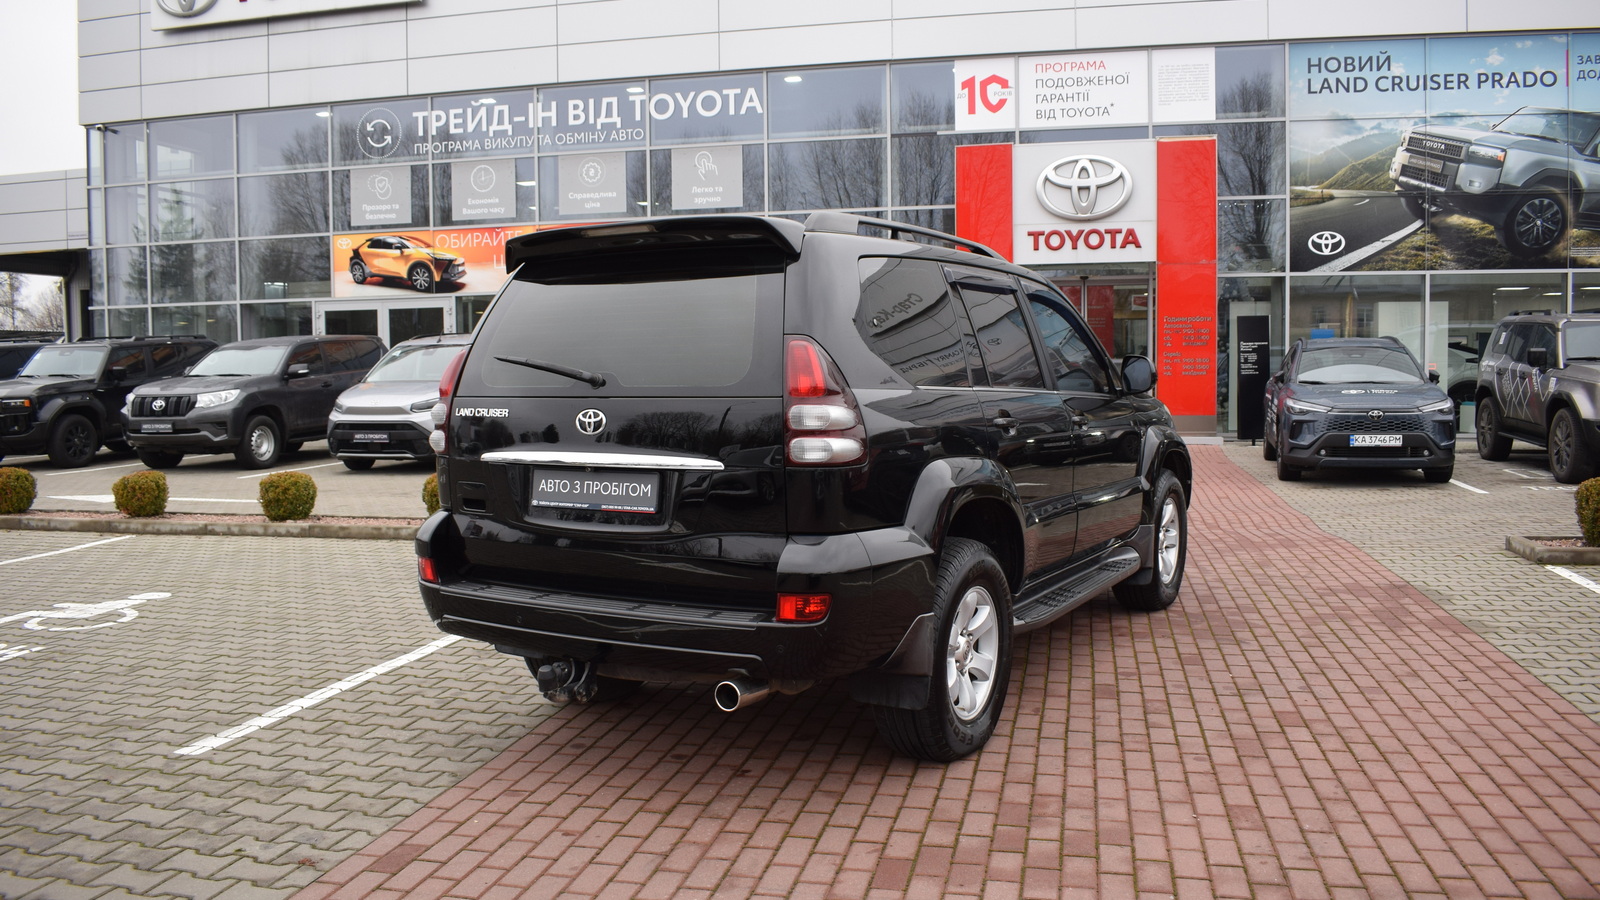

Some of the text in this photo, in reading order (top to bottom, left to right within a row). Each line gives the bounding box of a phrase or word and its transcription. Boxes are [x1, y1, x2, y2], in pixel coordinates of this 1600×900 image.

[1035, 60, 1106, 73] ПРОГРАМА
[1307, 50, 1391, 74] НОВИЙ
[1035, 72, 1130, 89] ПОДОВЖЕНОЇ
[1576, 69, 1600, 81] ДО
[1307, 70, 1558, 94] LAND CRUISER PRADO
[1035, 89, 1090, 104] ГАРАНТІЇ
[412, 87, 764, 137] ТРЕЙД-ІН ВІД TOYOTA
[1035, 108, 1056, 120] ВІД
[414, 128, 645, 155] ПРОГРАМА ВИКУПУ ТА ОБМІНУ АВТО
[1422, 140, 1445, 150] TOYOTA
[467, 197, 499, 205] Економія
[568, 191, 617, 200] Справедлива
[694, 196, 722, 204] зручно
[362, 203, 391, 212] Прозоро
[462, 206, 505, 215] Вашого часу
[584, 201, 600, 209] ціна
[1027, 228, 1142, 251] TOYOTA
[455, 407, 510, 417] LAND CRUISER
[1355, 435, 1401, 444] KA 3746 PM
[539, 479, 570, 493] АВТО
[583, 480, 652, 497] ПРОБІГОМ
